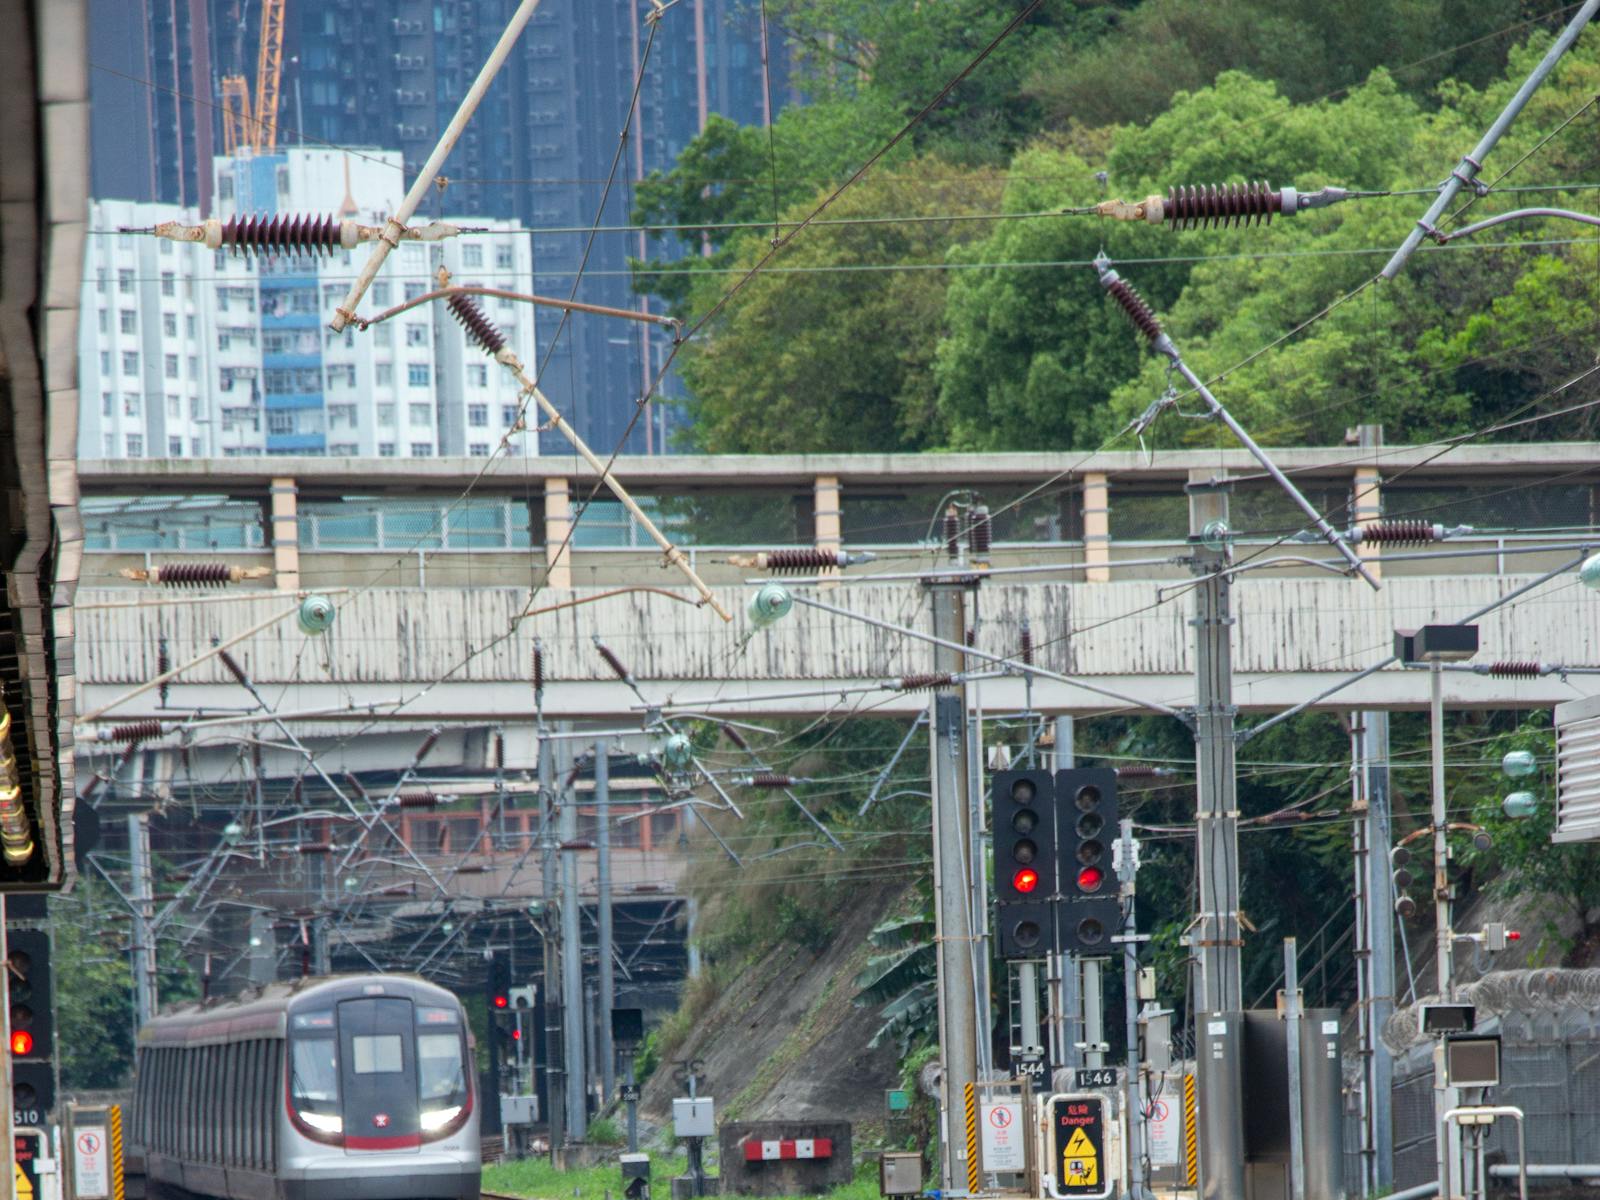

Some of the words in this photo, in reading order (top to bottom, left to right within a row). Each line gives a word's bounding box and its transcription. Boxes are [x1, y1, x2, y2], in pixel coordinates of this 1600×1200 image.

[1016, 1062, 1045, 1076] 1544
[1080, 1072, 1112, 1086] 1546
[1061, 1115, 1095, 1127] Danger
